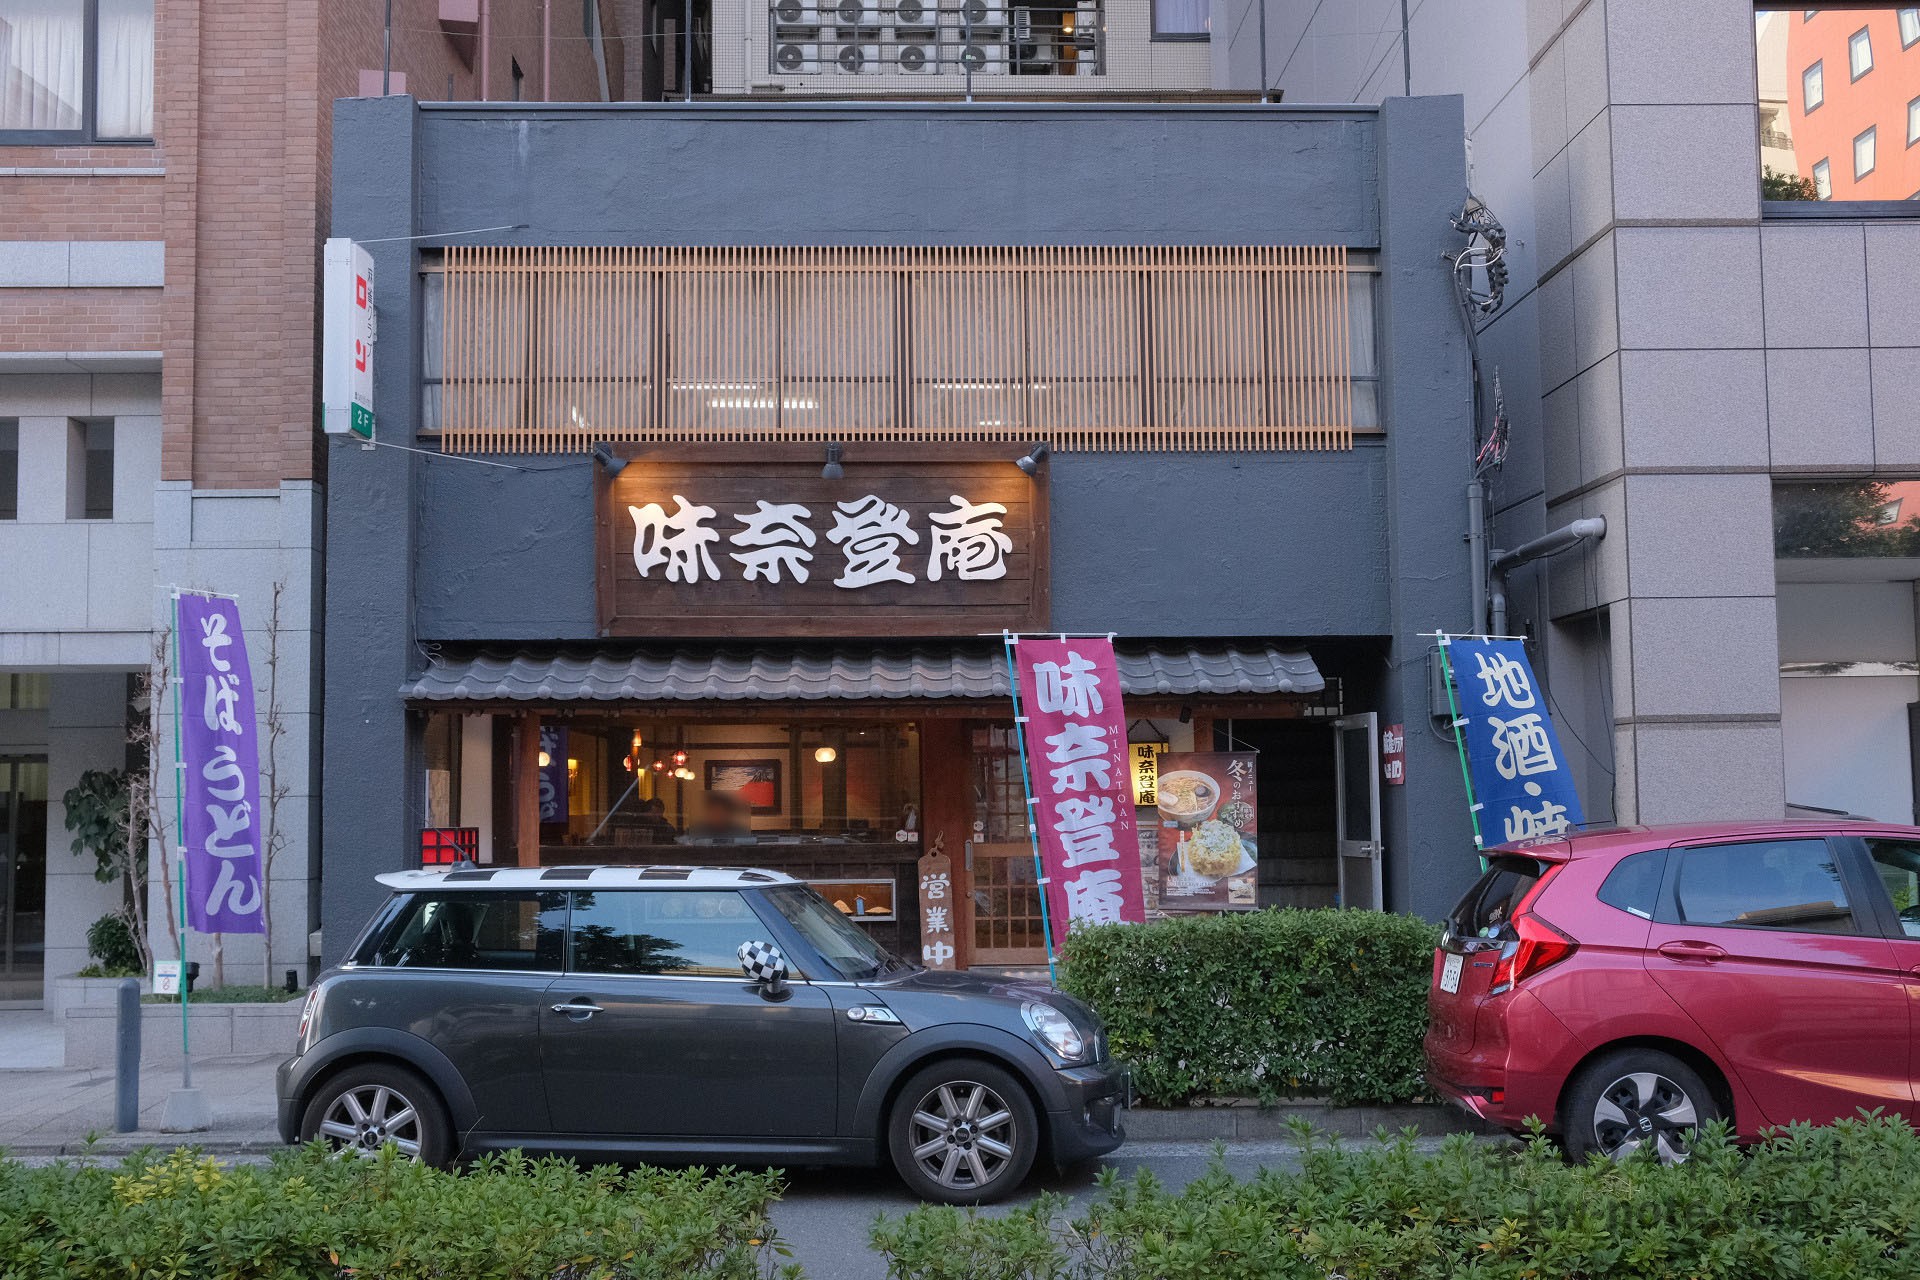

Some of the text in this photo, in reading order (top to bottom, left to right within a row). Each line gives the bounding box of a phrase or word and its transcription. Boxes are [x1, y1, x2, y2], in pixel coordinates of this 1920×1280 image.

[357, 409, 369, 428] 2F
[627, 494, 1013, 589] 味奈登庵
[1109, 725, 1129, 831] MINATOAN
[1137, 744, 1156, 805] 味奈登庵
[1226, 759, 1247, 829] 冬のおすすめ
[920, 873, 954, 966] 営業中
